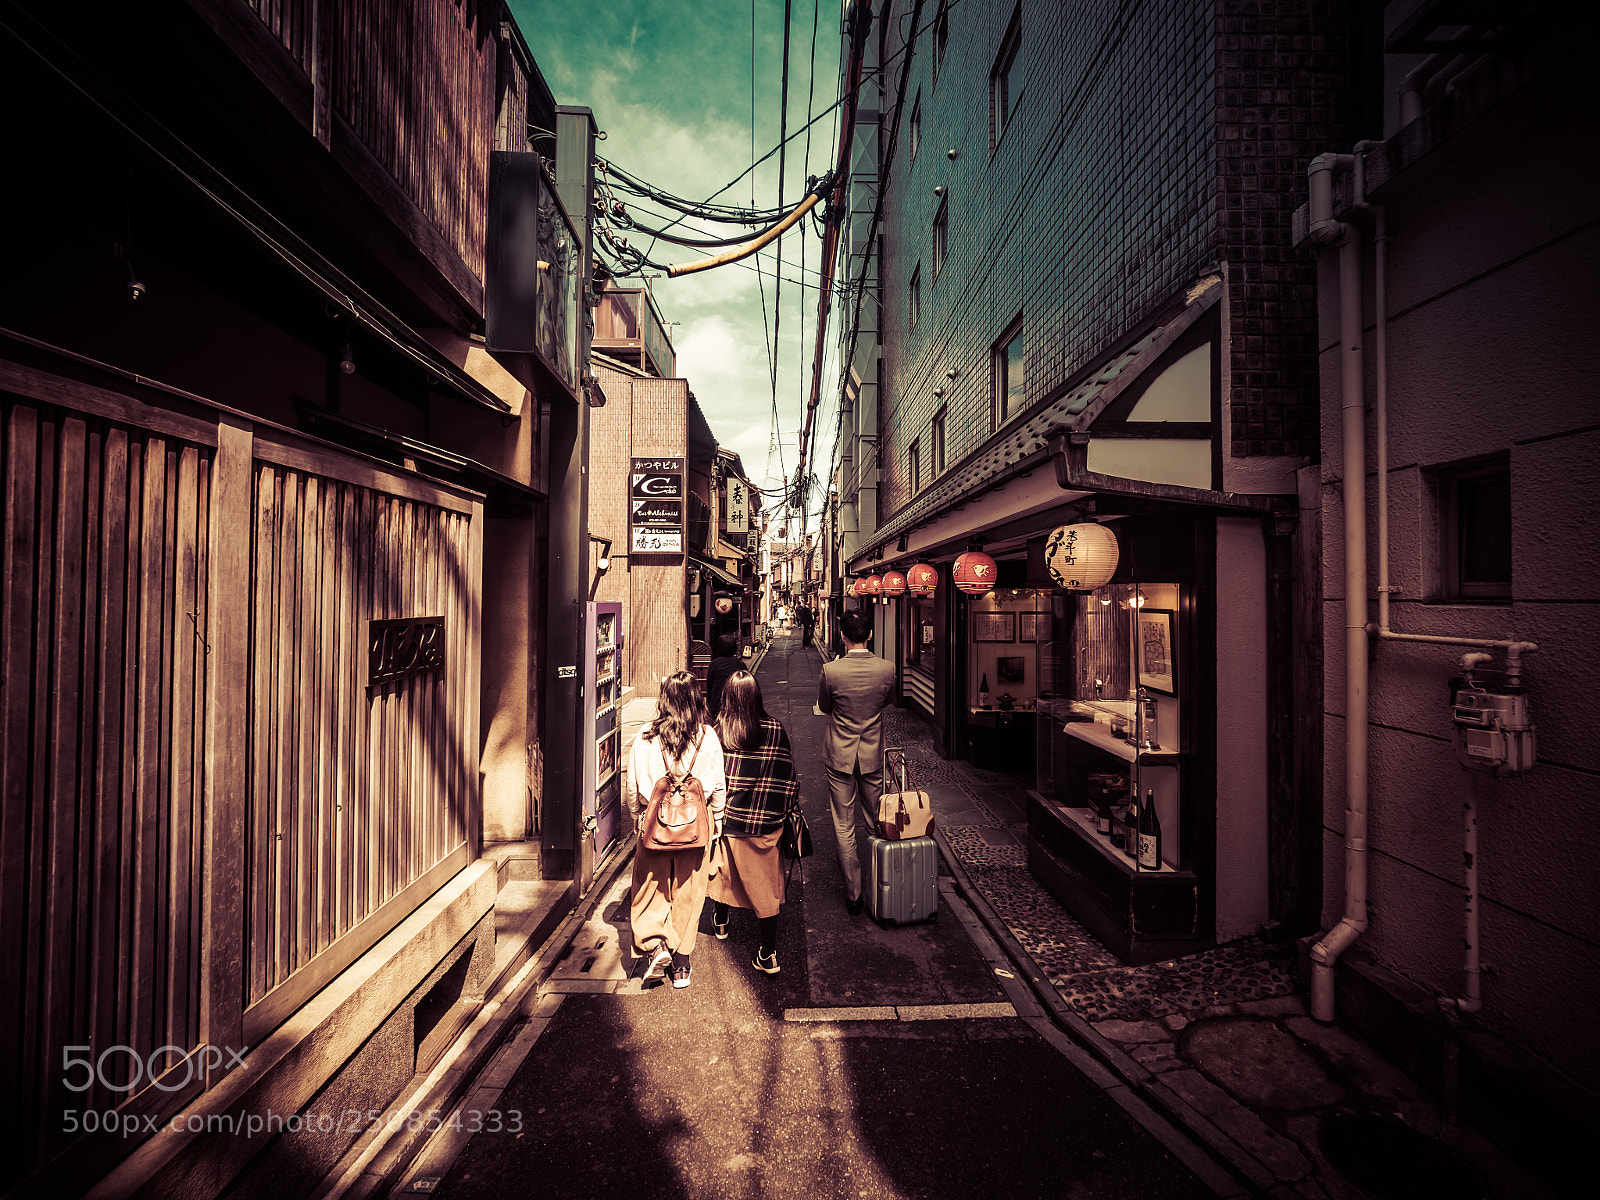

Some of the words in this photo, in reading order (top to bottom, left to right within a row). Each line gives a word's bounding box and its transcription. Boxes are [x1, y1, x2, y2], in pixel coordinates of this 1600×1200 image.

[634, 461, 679, 470] かつやビル
